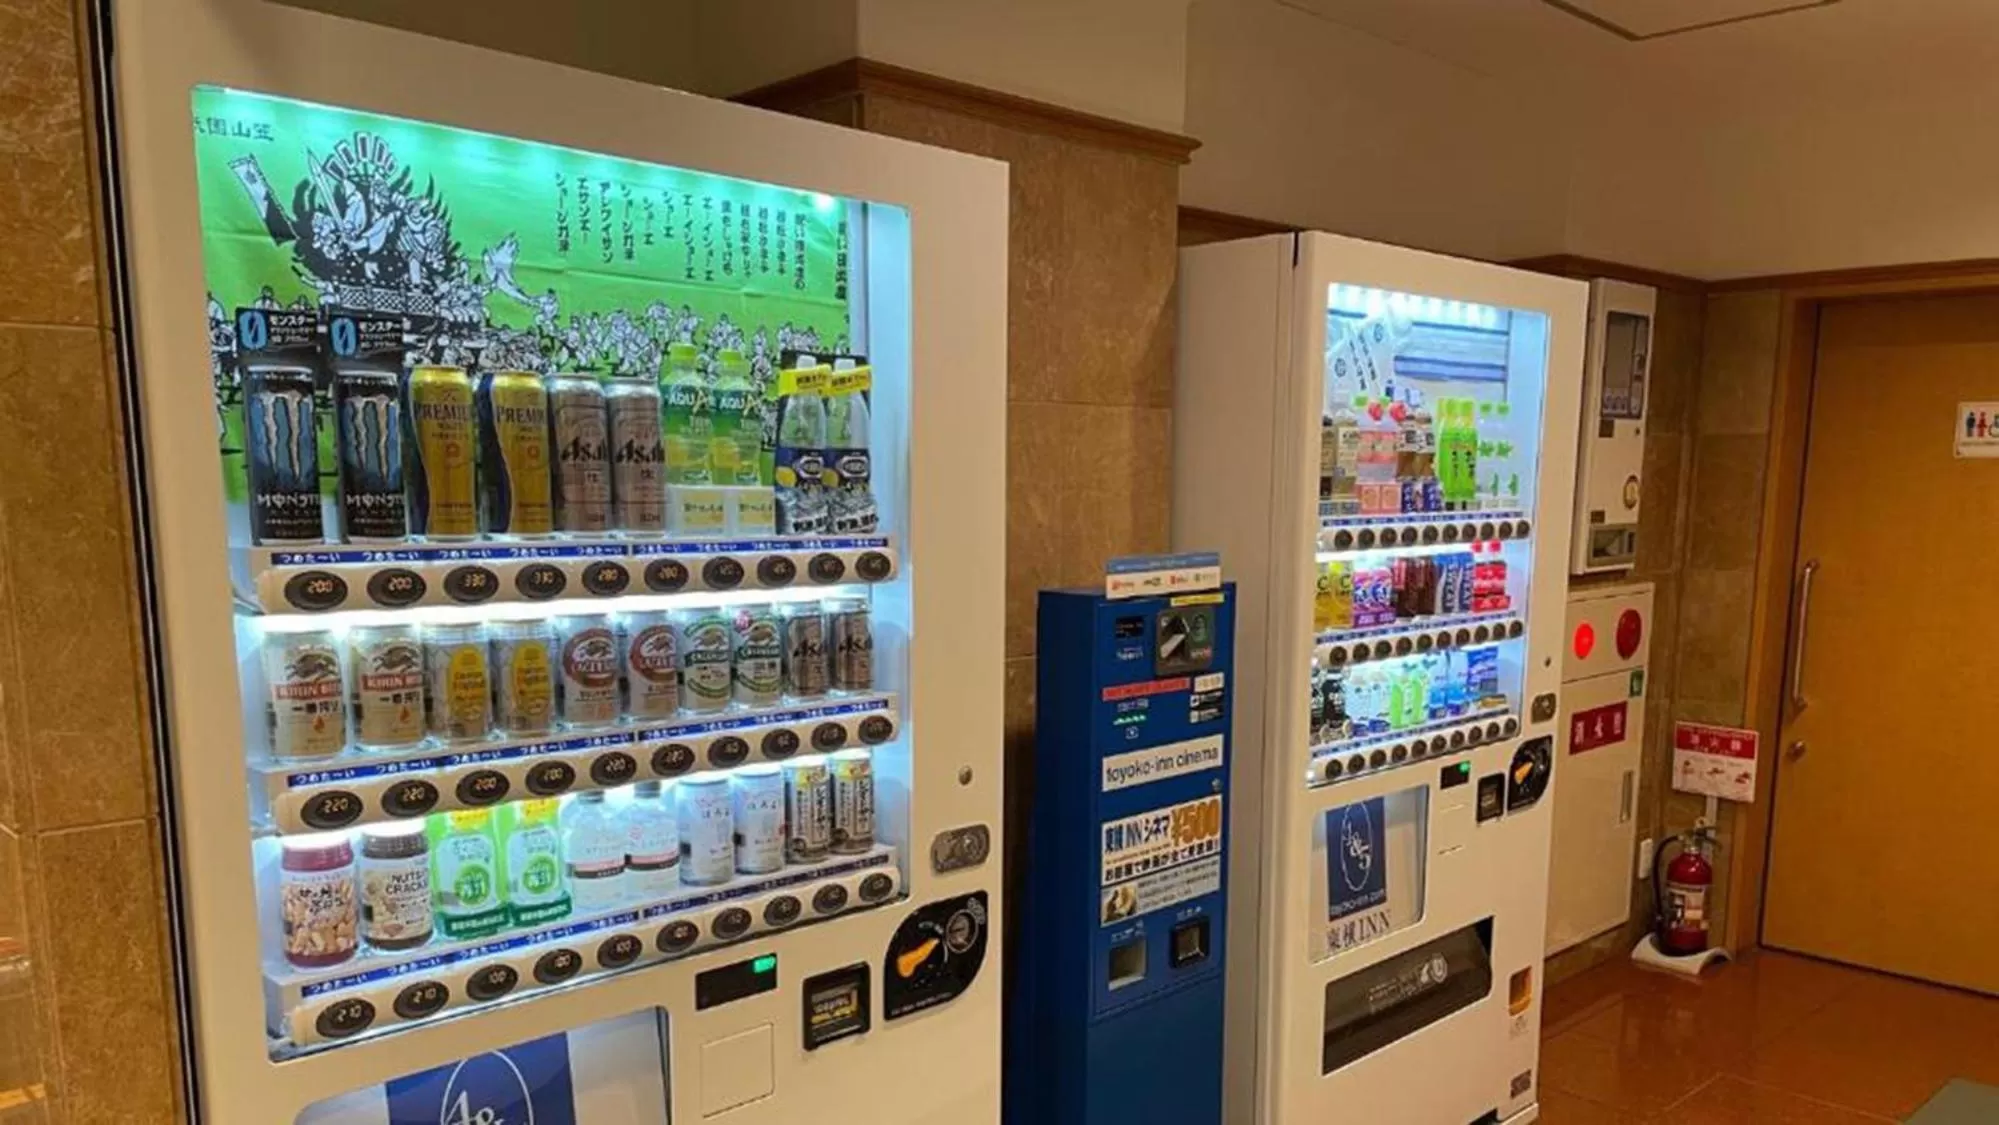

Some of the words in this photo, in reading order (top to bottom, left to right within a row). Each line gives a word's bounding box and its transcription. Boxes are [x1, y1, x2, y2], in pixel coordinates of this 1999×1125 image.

[269, 315, 316, 325] モンスター
[359, 321, 400, 332] モンスター
[377, 760, 432, 773] つめた〜い
[1106, 755, 1174, 784] toyoko-inn
[1176, 747, 1219, 767] cinema
[296, 770, 356, 784] つめた〜い
[324, 797, 349, 814] 220
[1171, 798, 1220, 848] ¥500
